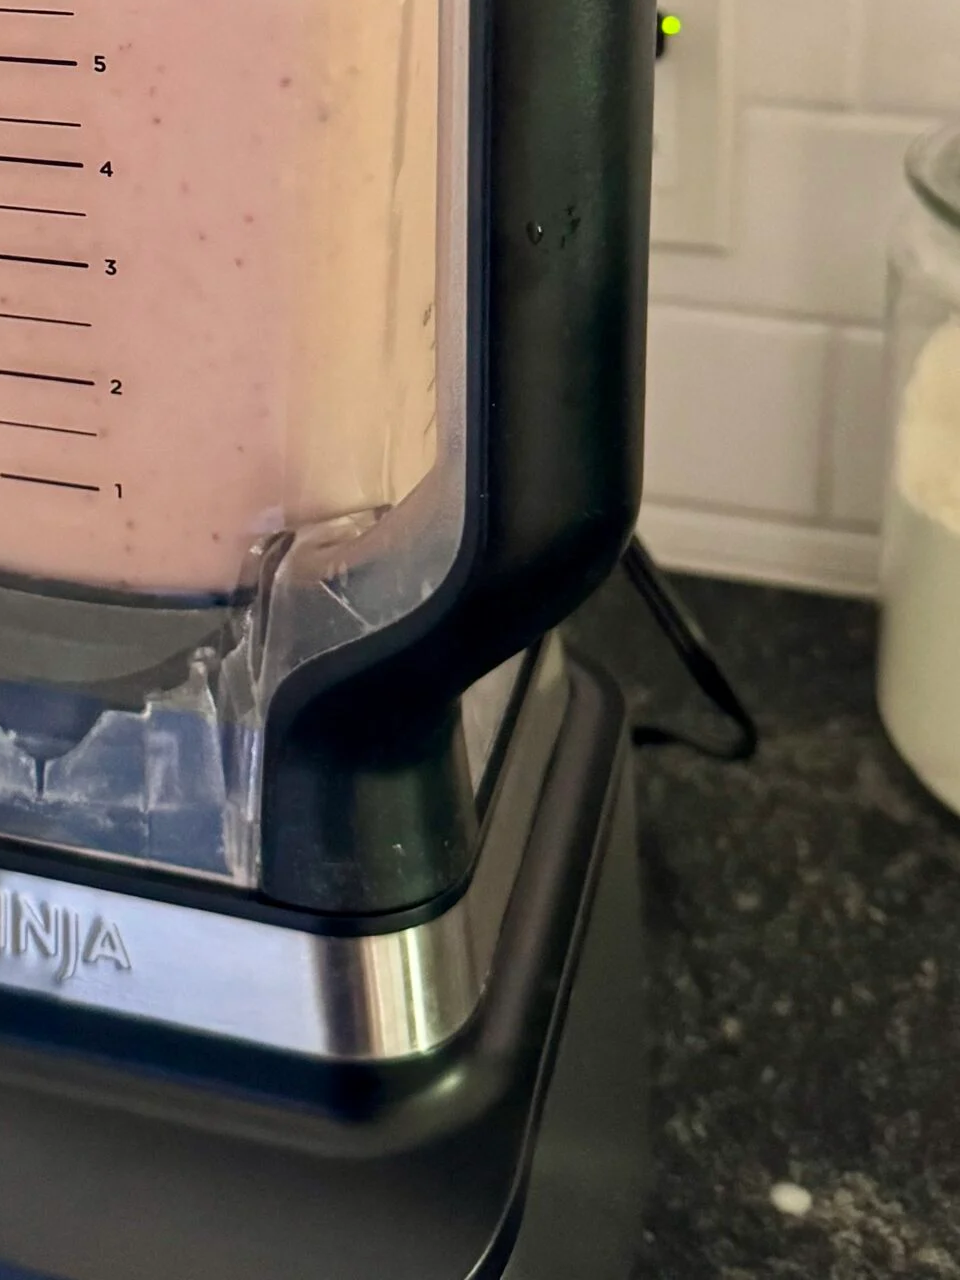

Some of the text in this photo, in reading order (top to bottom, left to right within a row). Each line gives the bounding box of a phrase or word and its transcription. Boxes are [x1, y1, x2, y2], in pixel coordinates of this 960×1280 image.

[93, 55, 107, 73] 5
[99, 160, 114, 178] 4
[104, 258, 118, 276] 3
[110, 378, 123, 396] 2
[114, 483, 123, 499] 1
